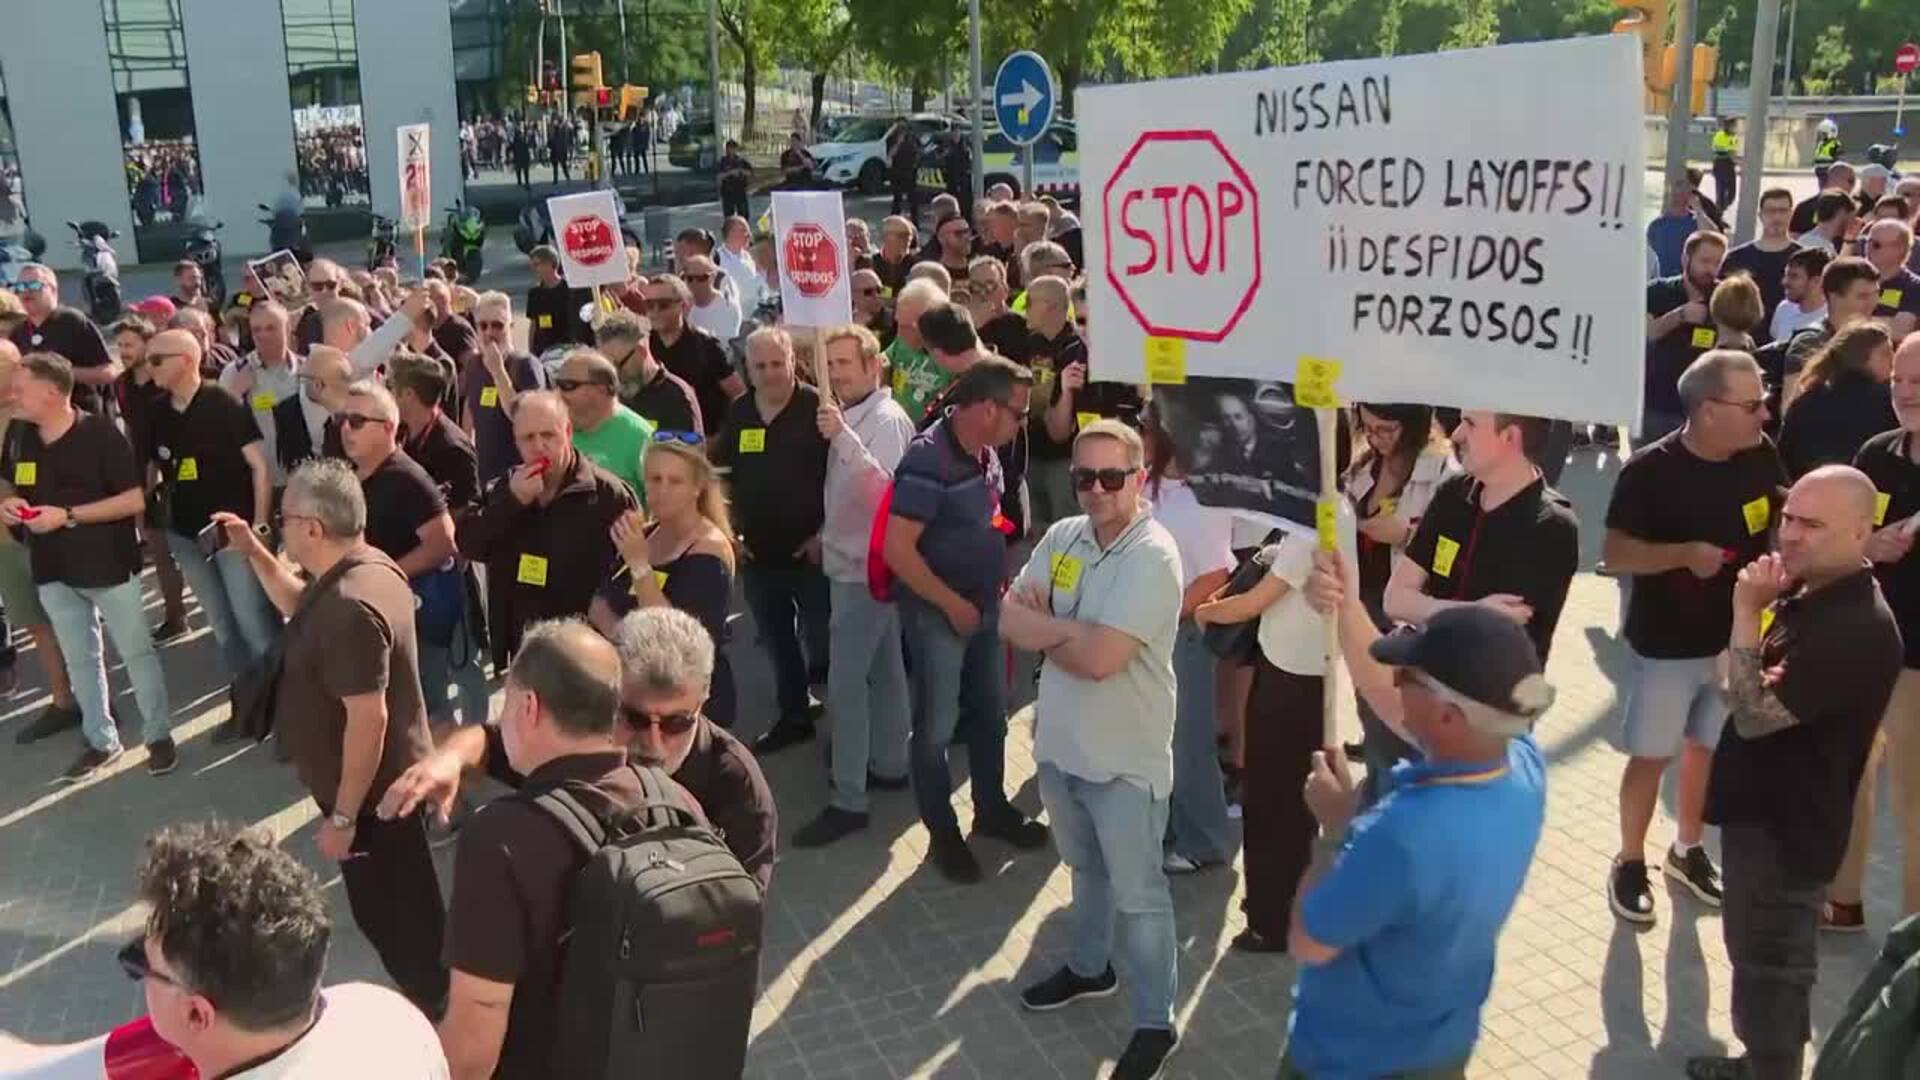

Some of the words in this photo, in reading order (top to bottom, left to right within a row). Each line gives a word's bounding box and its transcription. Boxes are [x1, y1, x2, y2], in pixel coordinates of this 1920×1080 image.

[1255, 75, 1391, 136] NISSAN
[1293, 157, 1425, 209] FORCED
[1444, 159, 1626, 230] LAYOFFS!!
[570, 220, 600, 234] STOP
[793, 232, 823, 248] STOP
[1121, 181, 1244, 276] STOP
[1353, 294, 1561, 350] FORZOSOS
